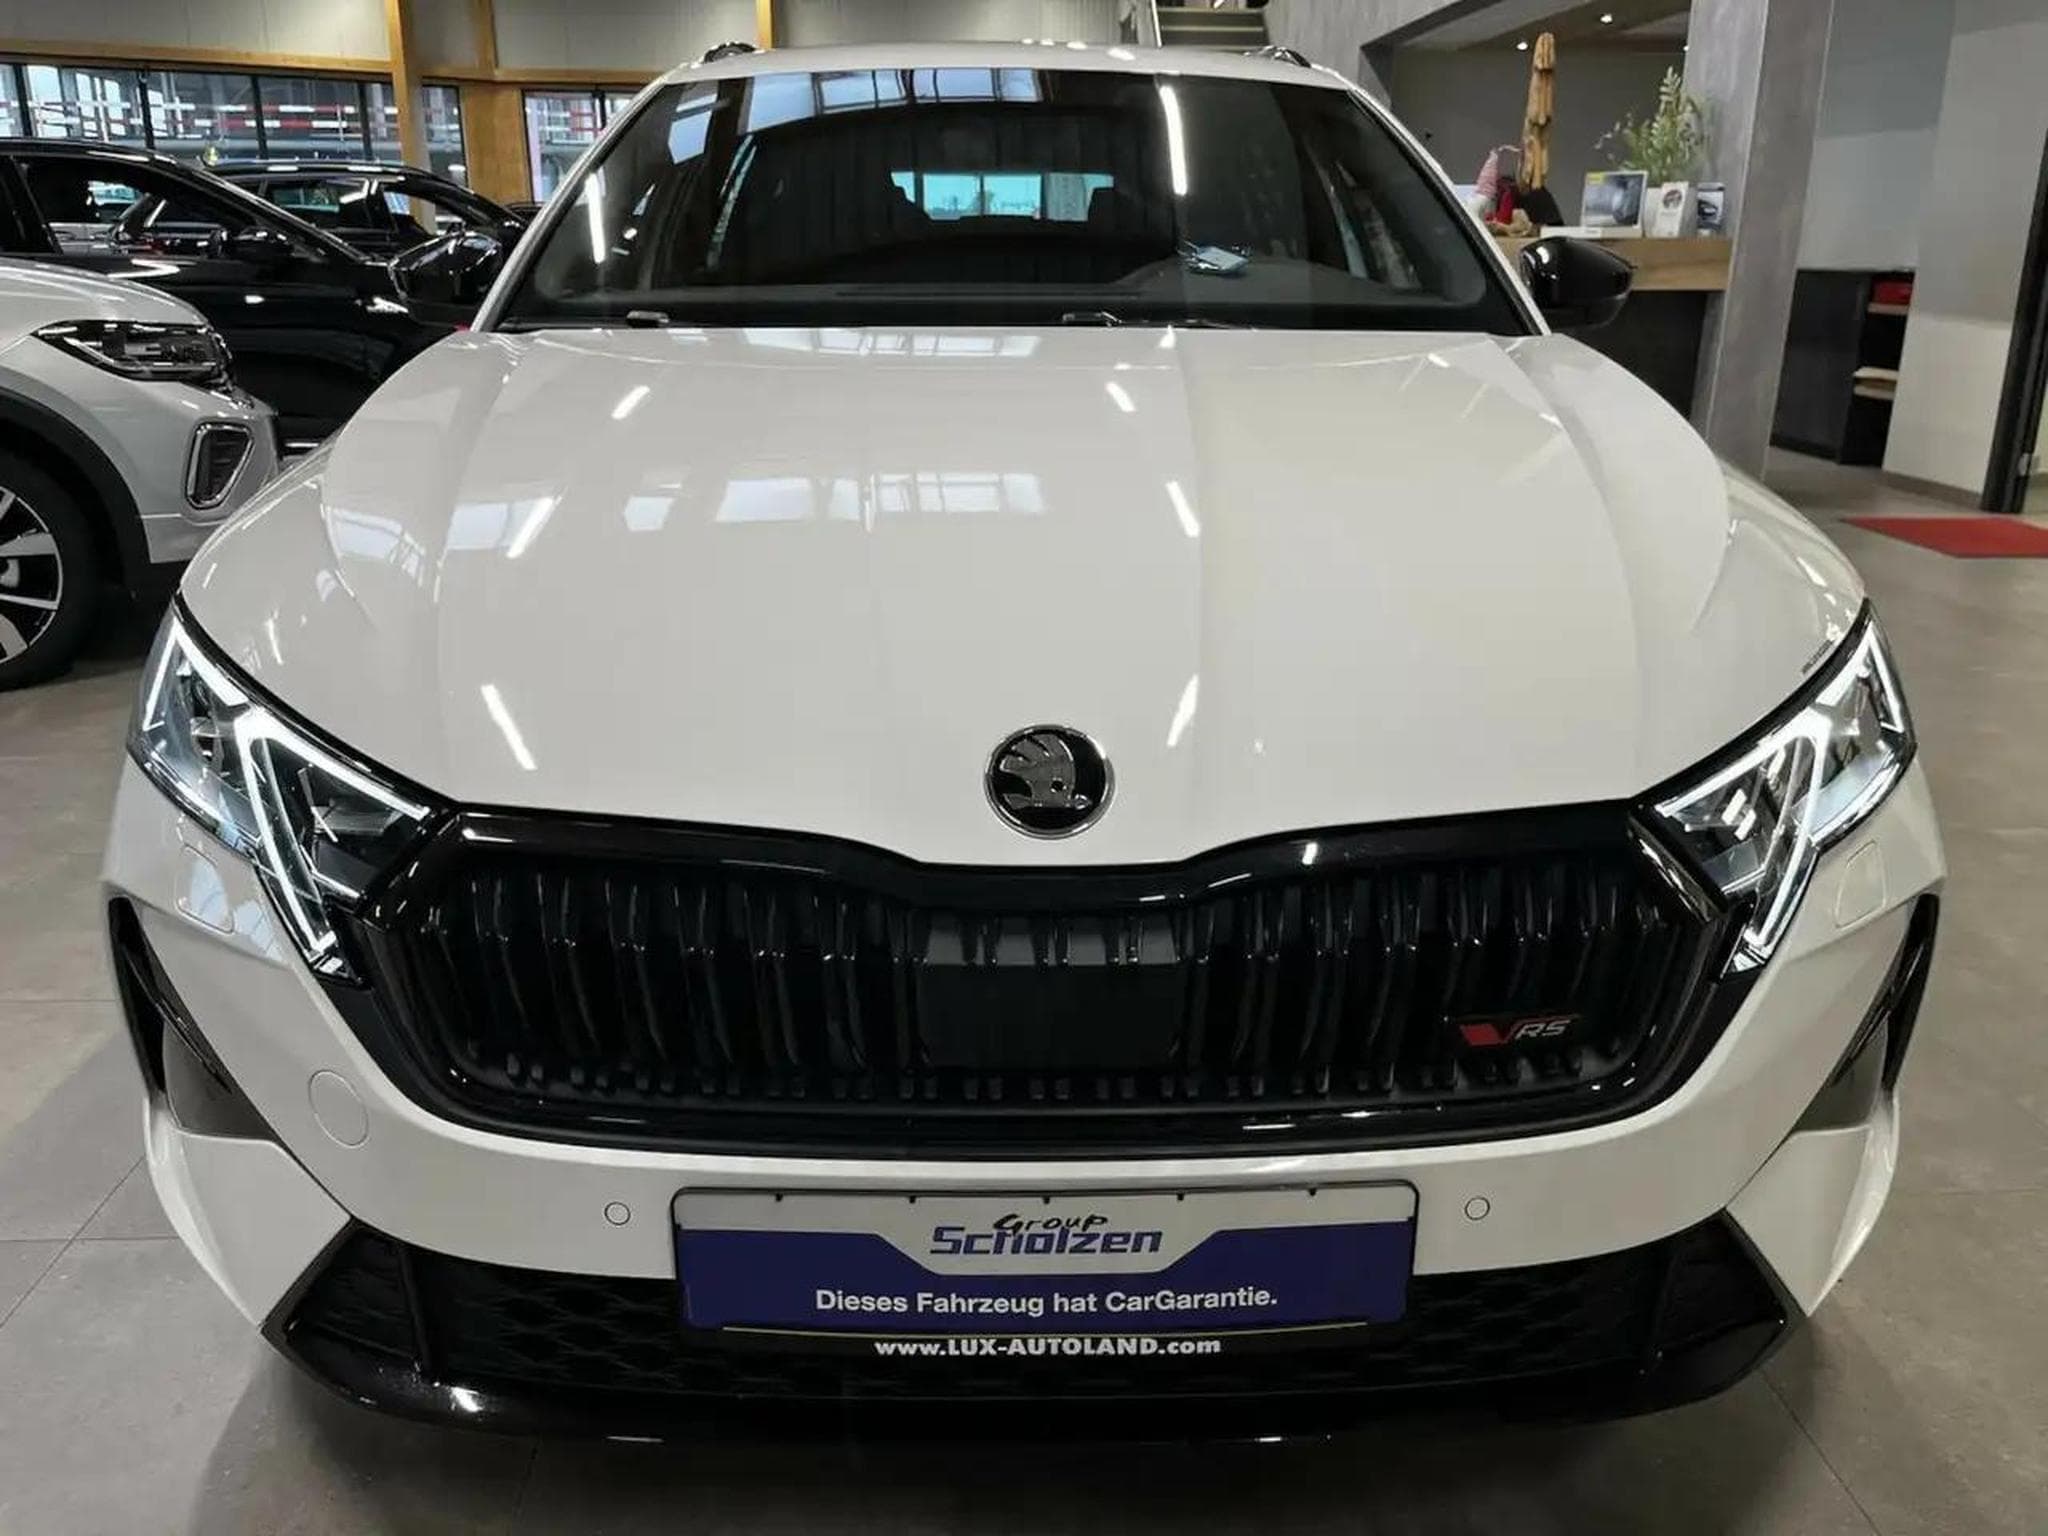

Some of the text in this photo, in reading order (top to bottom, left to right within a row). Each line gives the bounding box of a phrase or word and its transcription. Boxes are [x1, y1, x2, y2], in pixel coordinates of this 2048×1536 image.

[993, 1213, 1109, 1236] Group
[930, 1226, 1163, 1255] Scholzen
[815, 1286, 1278, 1317] Dieses Fahrzeug hat CarGarantie.
[874, 1338, 1221, 1356] www.LUX-AUTOLAND.com
